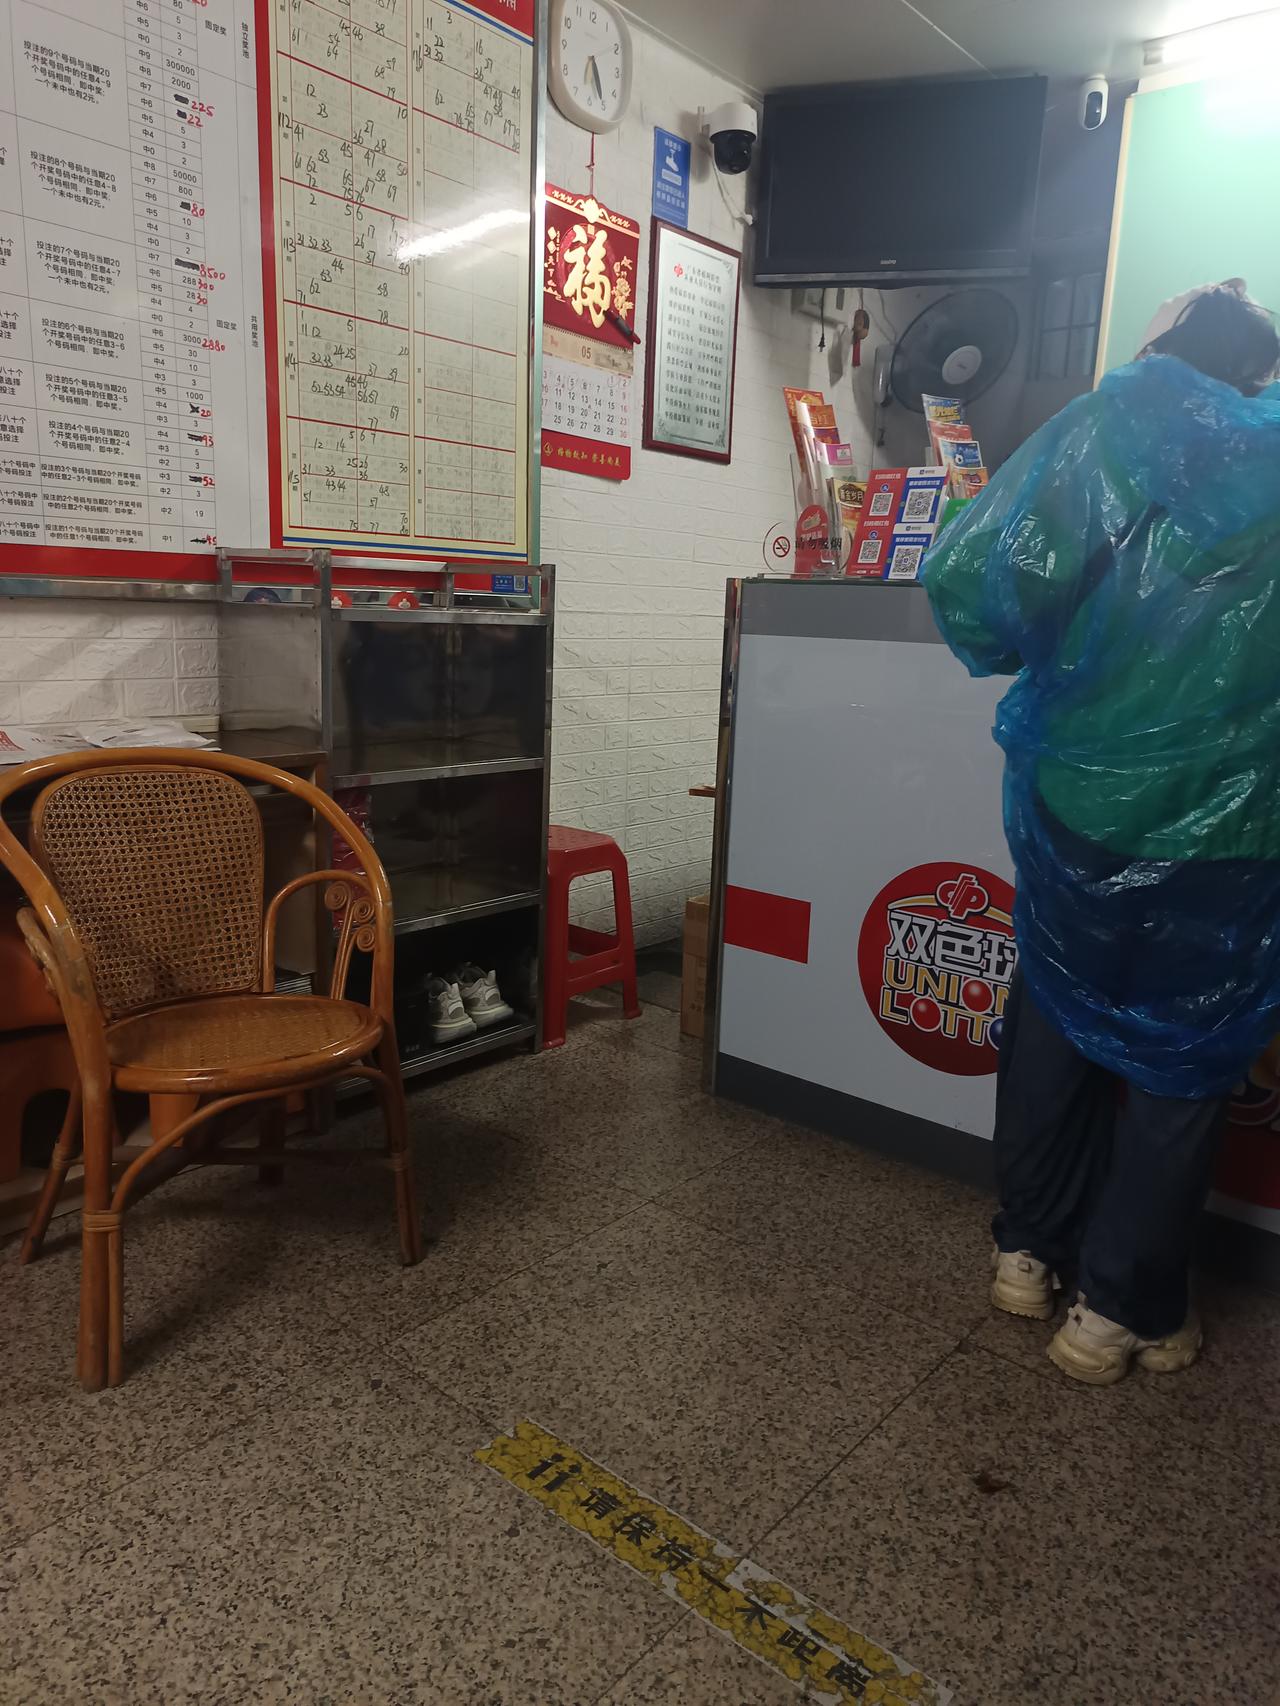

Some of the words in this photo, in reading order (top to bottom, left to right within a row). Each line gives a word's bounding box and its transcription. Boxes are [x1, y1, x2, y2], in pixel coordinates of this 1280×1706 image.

[136, 0, 148, 11] 中6
[576, 6, 581, 17] 11
[137, 17, 149, 27] 中5
[590, 11, 597, 24] 12
[564, 16, 571, 29] 10
[137, 33, 150, 43] 中0
[562, 39, 567, 50] 9
[614, 43, 619, 55] 2
[139, 65, 152, 76] 中8
[166, 59, 195, 76] 300000
[563, 64, 568, 76] 8
[615, 67, 620, 78] 3
[140, 82, 152, 92] 中7
[171, 77, 191, 90] 2000
[612, 89, 617, 99] 4
[191, 101, 216, 118] 225
[601, 101, 606, 111] 5
[142, 113, 154, 123] 中5
[187, 114, 204, 128] 22
[142, 129, 154, 138] 中4
[144, 161, 156, 171] 中8
[144, 176, 156, 184] 中7
[173, 170, 197, 183] 50000
[178, 186, 193, 196] 800
[146, 208, 158, 217] 中5
[191, 203, 205, 217] 80
[183, 218, 192, 226] 10
[147, 223, 158, 231] 中4
[148, 252, 160, 261] 中7
[149, 268, 161, 277] 中6
[200, 264, 226, 280] 8500
[563, 224, 611, 328] 福
[182, 276, 196, 286] 288
[186, 291, 196, 300] 28
[151, 298, 162, 306] 中4
[152, 313, 163, 322] 中0
[183, 334, 201, 345] 3000
[153, 343, 165, 352] 中5
[202, 338, 225, 352] 2880
[188, 350, 197, 358] 30
[581, 344, 591, 359] 05
[154, 358, 165, 366] 中4
[189, 364, 198, 372] 10
[155, 387, 167, 395] 中5
[555, 388, 562, 396] 11
[186, 392, 204, 400] 1000
[568, 392, 575, 400] 12
[581, 395, 588, 403] 13
[156, 401, 167, 409] 中4
[555, 402, 562, 410] 18
[595, 399, 602, 407] 14
[608, 402, 615, 410] 15
[200, 410, 211, 418] 20
[568, 406, 575, 414] 19
[581, 408, 588, 417] 20
[554, 416, 561, 424] 25
[567, 419, 574, 427] 26
[607, 415, 614, 423] 22
[620, 418, 627, 426] 23
[580, 422, 587, 430] 27
[594, 425, 601, 433] 28
[158, 430, 168, 438] 中4
[607, 428, 614, 436] 29
[158, 444, 170, 452] 中3
[160, 487, 171, 495] 中2
[161, 506, 172, 515] 中2
[195, 509, 204, 518] 19
[162, 534, 172, 542] 中1
